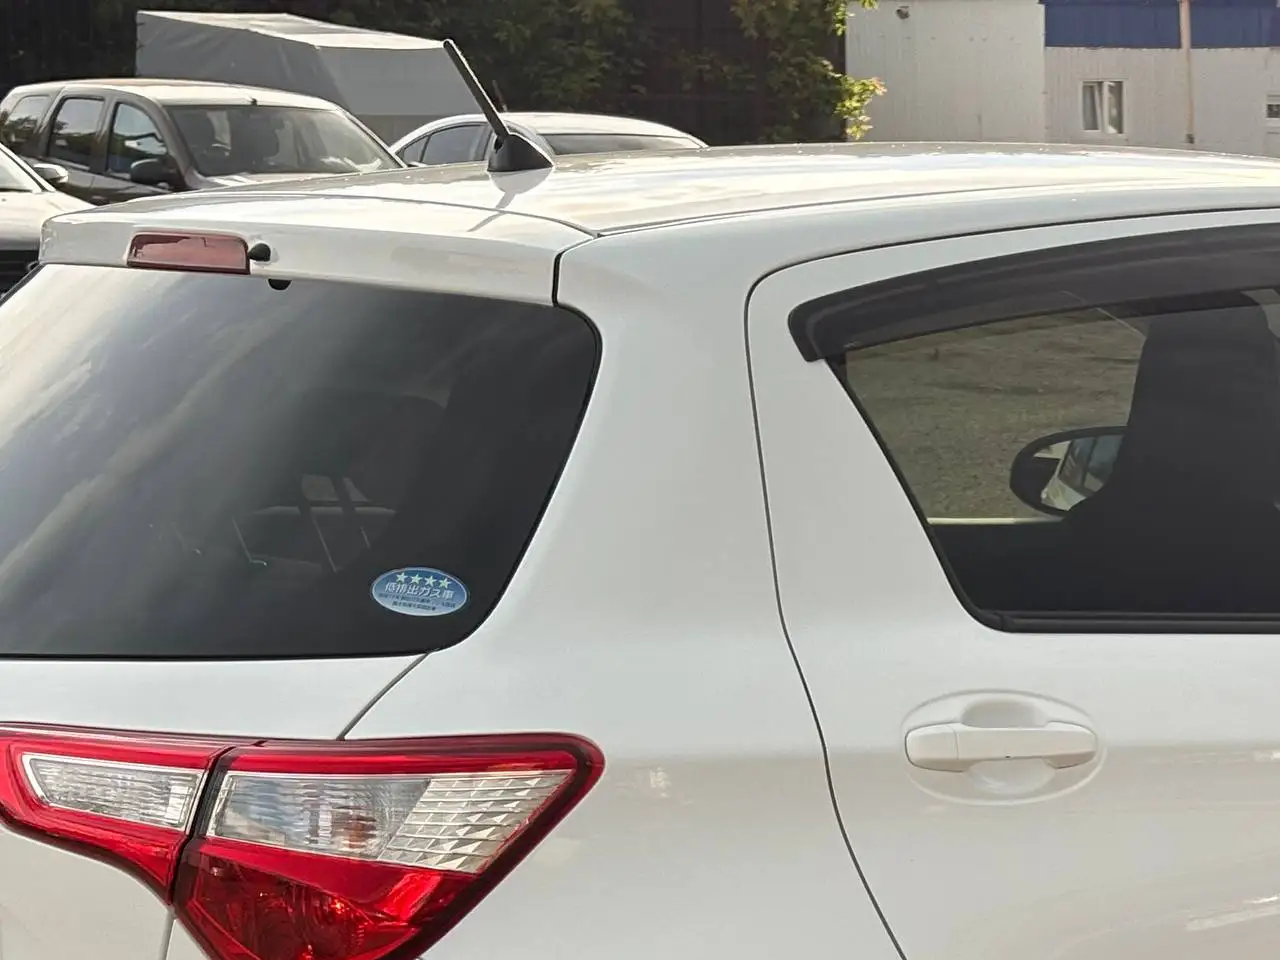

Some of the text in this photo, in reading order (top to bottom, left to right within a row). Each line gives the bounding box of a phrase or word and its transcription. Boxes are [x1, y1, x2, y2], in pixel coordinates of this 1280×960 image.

[385, 581, 455, 600] 低排出ガス車
